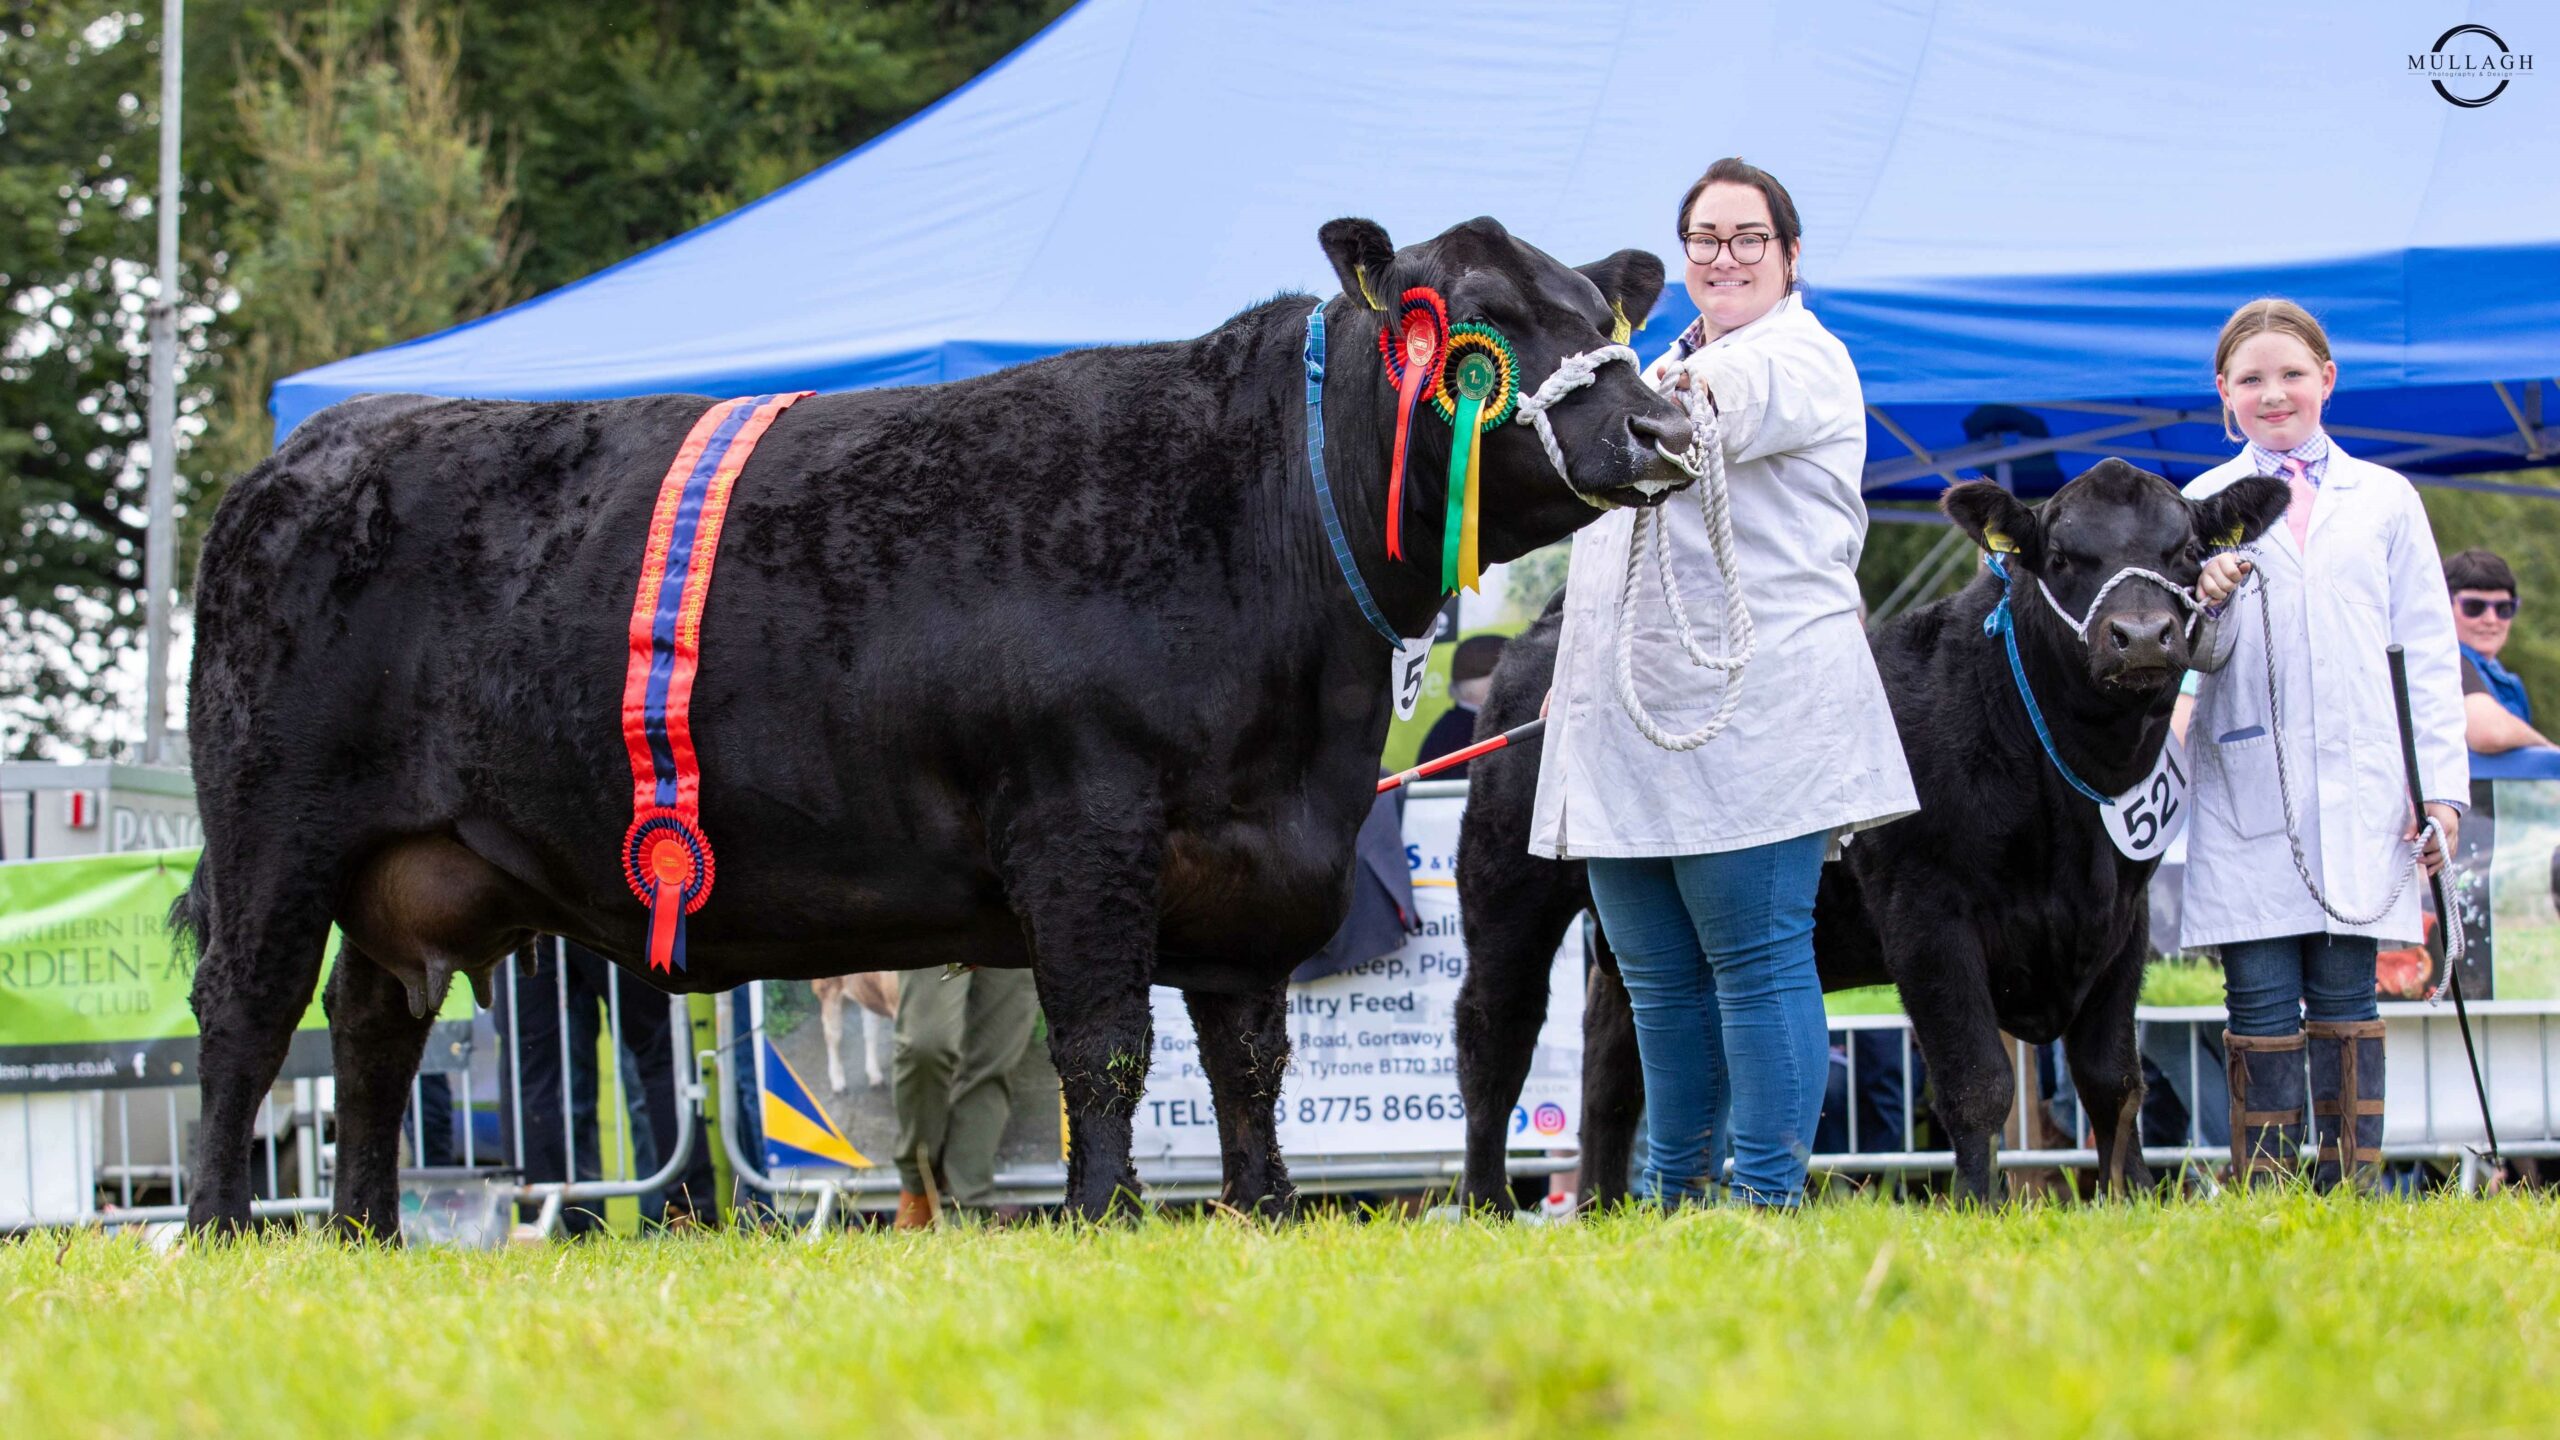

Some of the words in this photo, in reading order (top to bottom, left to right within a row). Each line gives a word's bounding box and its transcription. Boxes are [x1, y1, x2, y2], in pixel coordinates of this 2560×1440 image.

[653, 523, 669, 561] VALLEY
[663, 488, 677, 518] SHOW
[700, 512, 720, 554] OVERALL
[694, 558, 708, 591] ANGUS
[684, 594, 699, 648] ABERDEEN
[1401, 648, 1429, 711] 5
[2123, 745, 2187, 850] 521
[0, 944, 191, 988] RDEEN-A
[1346, 957, 1410, 980] eep,
[1420, 952, 1462, 978] Pig
[74, 990, 151, 1016] CLUB
[1350, 990, 1415, 1012] Feed
[1161, 1036, 1193, 1051] Gor
[1300, 1032, 1352, 1049] Road,
[1358, 1031, 1444, 1048] Gortavoy
[0, 1057, 117, 1082] een-angus.co.uk
[1309, 1060, 1374, 1080] Tyrone
[1379, 1058, 1425, 1074] BT70
[1431, 1057, 1457, 1073] 3D
[1149, 1101, 1214, 1126] TEL:
[1299, 1096, 1371, 1123] 8775
[1383, 1094, 1465, 1121] 8663
